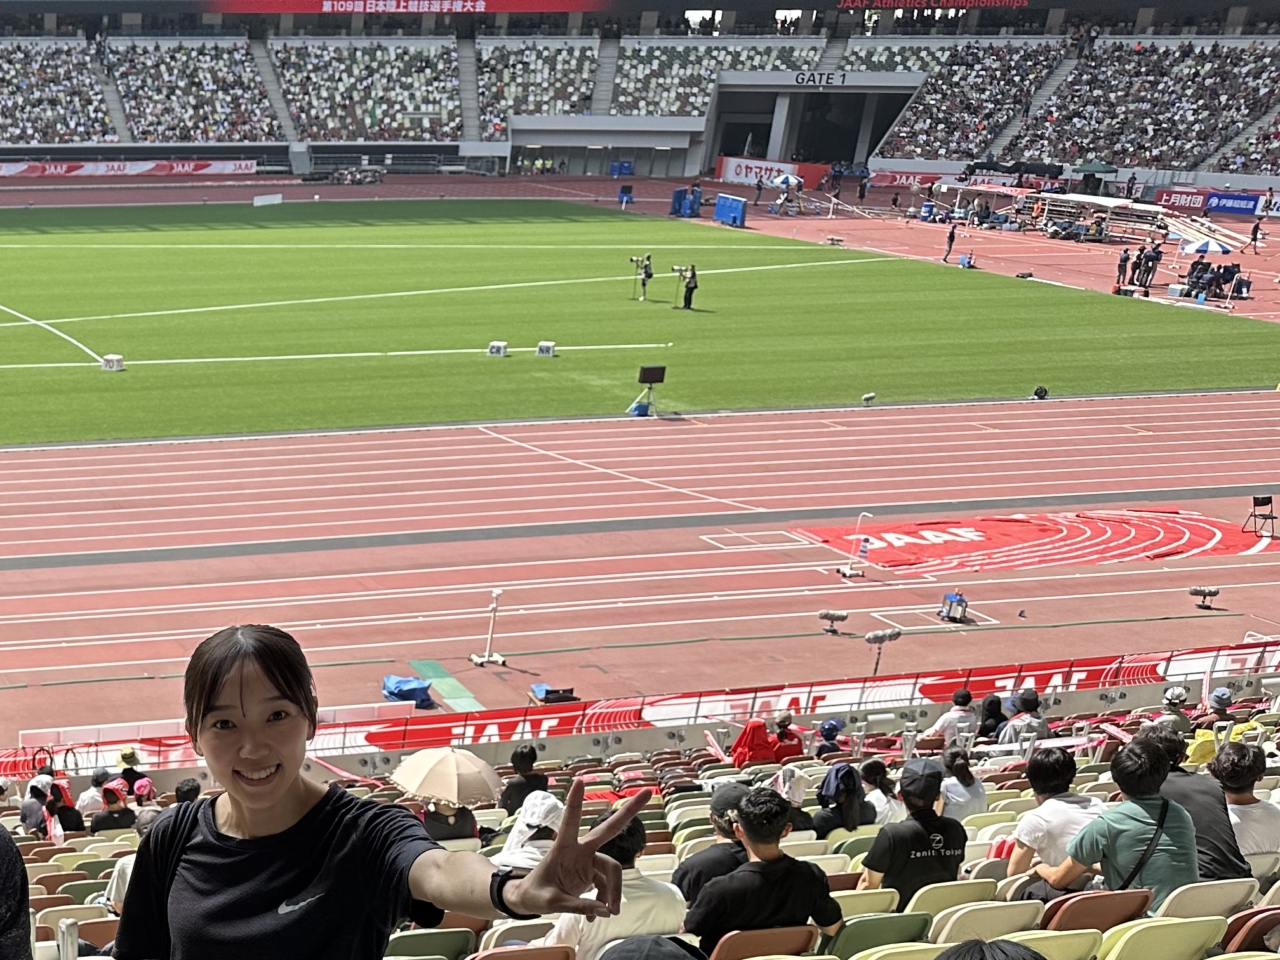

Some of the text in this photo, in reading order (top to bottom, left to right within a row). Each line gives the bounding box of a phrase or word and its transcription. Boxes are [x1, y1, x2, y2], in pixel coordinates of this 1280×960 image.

[795, 73, 847, 85] GATE 1
[44, 164, 67, 175] JAAF
[105, 163, 128, 173] JAAF
[172, 163, 196, 173] JAAF
[232, 162, 255, 172] JAAF
[893, 175, 921, 185] JAAF
[1157, 193, 1204, 208] 上月財団
[843, 527, 986, 550] JAAF
[910, 849, 938, 859] Zenit
